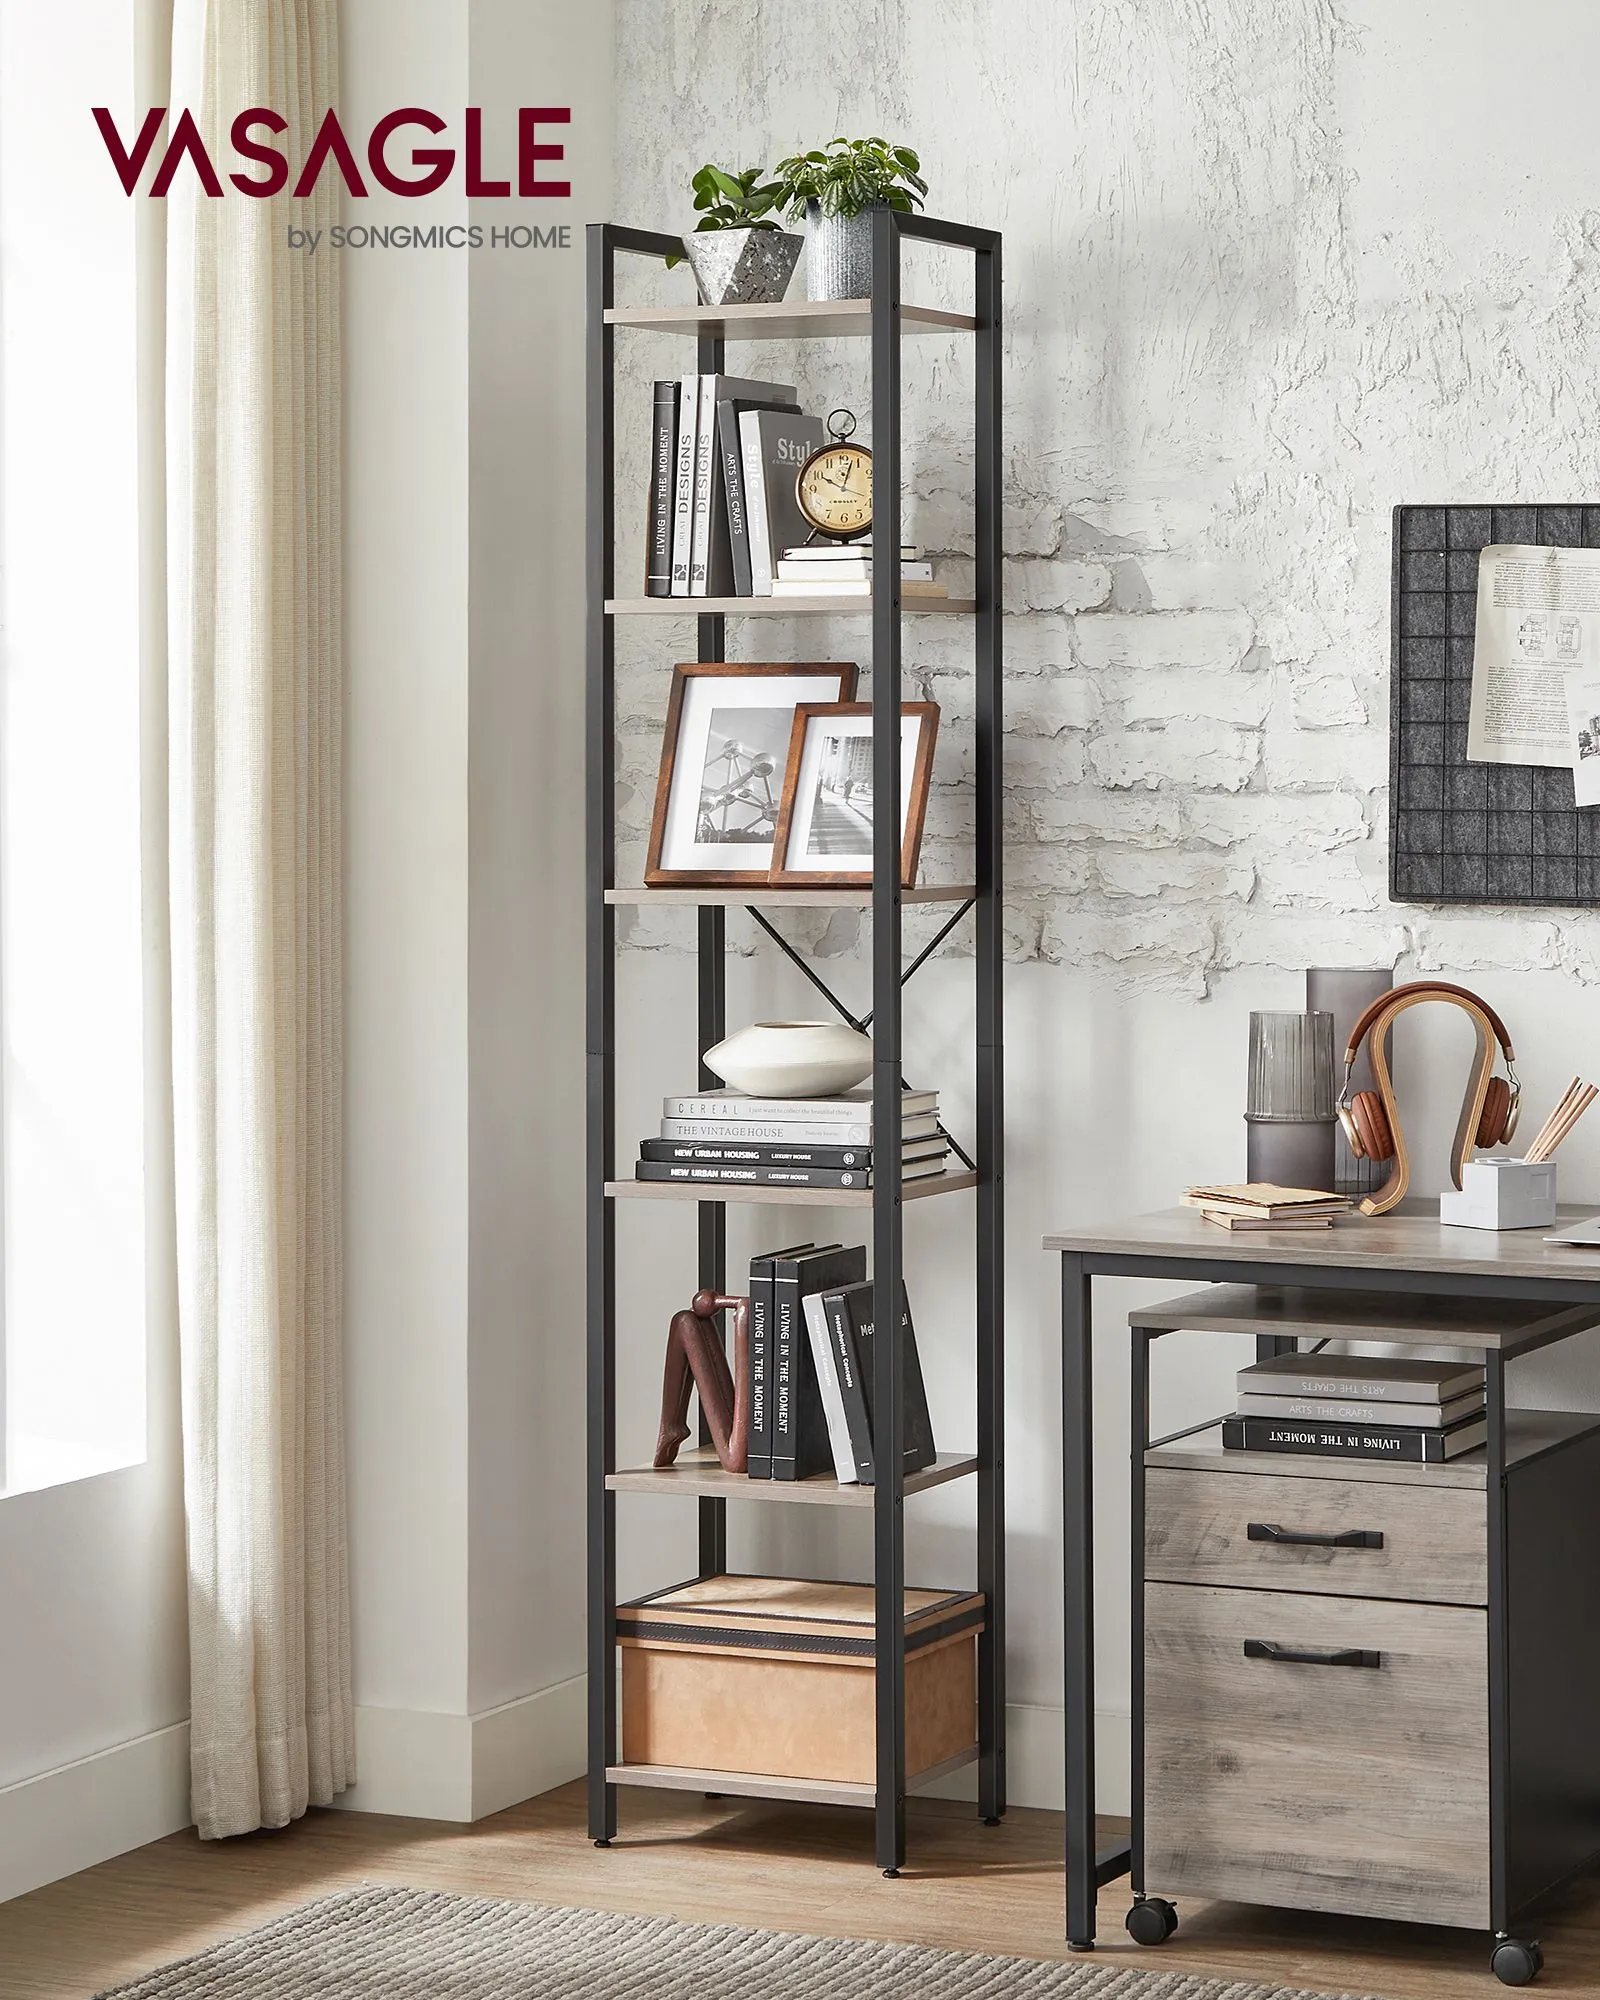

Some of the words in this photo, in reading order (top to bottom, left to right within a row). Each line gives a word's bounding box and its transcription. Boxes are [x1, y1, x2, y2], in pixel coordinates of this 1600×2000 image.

[659, 427, 669, 473] MOMENT
[727, 453, 737, 476] ARTS
[747, 444, 761, 488] Style
[678, 434, 692, 514] DESIGNS
[697, 434, 710, 514] DESIGNS
[813, 470, 824, 481] 10
[659, 477, 668, 500] THE
[729, 479, 739, 497] THE
[809, 484, 818, 494] 9
[658, 503, 667, 514] IN
[825, 509, 832, 519] 7
[854, 509, 863, 520] 5
[731, 501, 742, 535] CRAFTS
[840, 513, 849, 523] 6
[656, 519, 666, 555] LIVING
[676, 1126, 698, 1135] THE
[701, 1126, 746, 1136] VINTAGE
[747, 1128, 784, 1138] HOUSE
[674, 1149, 693, 1157] NEW
[694, 1149, 722, 1158] URBAN
[724, 1150, 760, 1160] HOUSING
[670, 1168, 690, 1177] NEW
[691, 1169, 719, 1178] URBAN
[720, 1170, 757, 1180] HOUSING
[754, 1302, 764, 1338] LIVING
[780, 1303, 791, 1340] LIVING
[754, 1343, 764, 1354] IN
[780, 1344, 789, 1356] IN
[834, 1314, 848, 1357] Metaphorical
[842, 1357, 853, 1388] Concepts
[754, 1358, 764, 1381] THE
[779, 1360, 789, 1382] THE
[1301, 1381, 1336, 1392] CRAFTS
[1340, 1383, 1358, 1393] THE
[1362, 1385, 1386, 1395] ARTS
[753, 1385, 764, 1432] MOMENT
[779, 1386, 789, 1434] MOMENT
[1289, 1405, 1312, 1415] ARTS
[1316, 1406, 1334, 1416] THE
[1338, 1407, 1374, 1419] CRAFTS
[1268, 1431, 1316, 1444] MOMENT
[1320, 1434, 1343, 1446] THE
[1347, 1436, 1359, 1447] IN
[1363, 1437, 1401, 1450] LIVING
